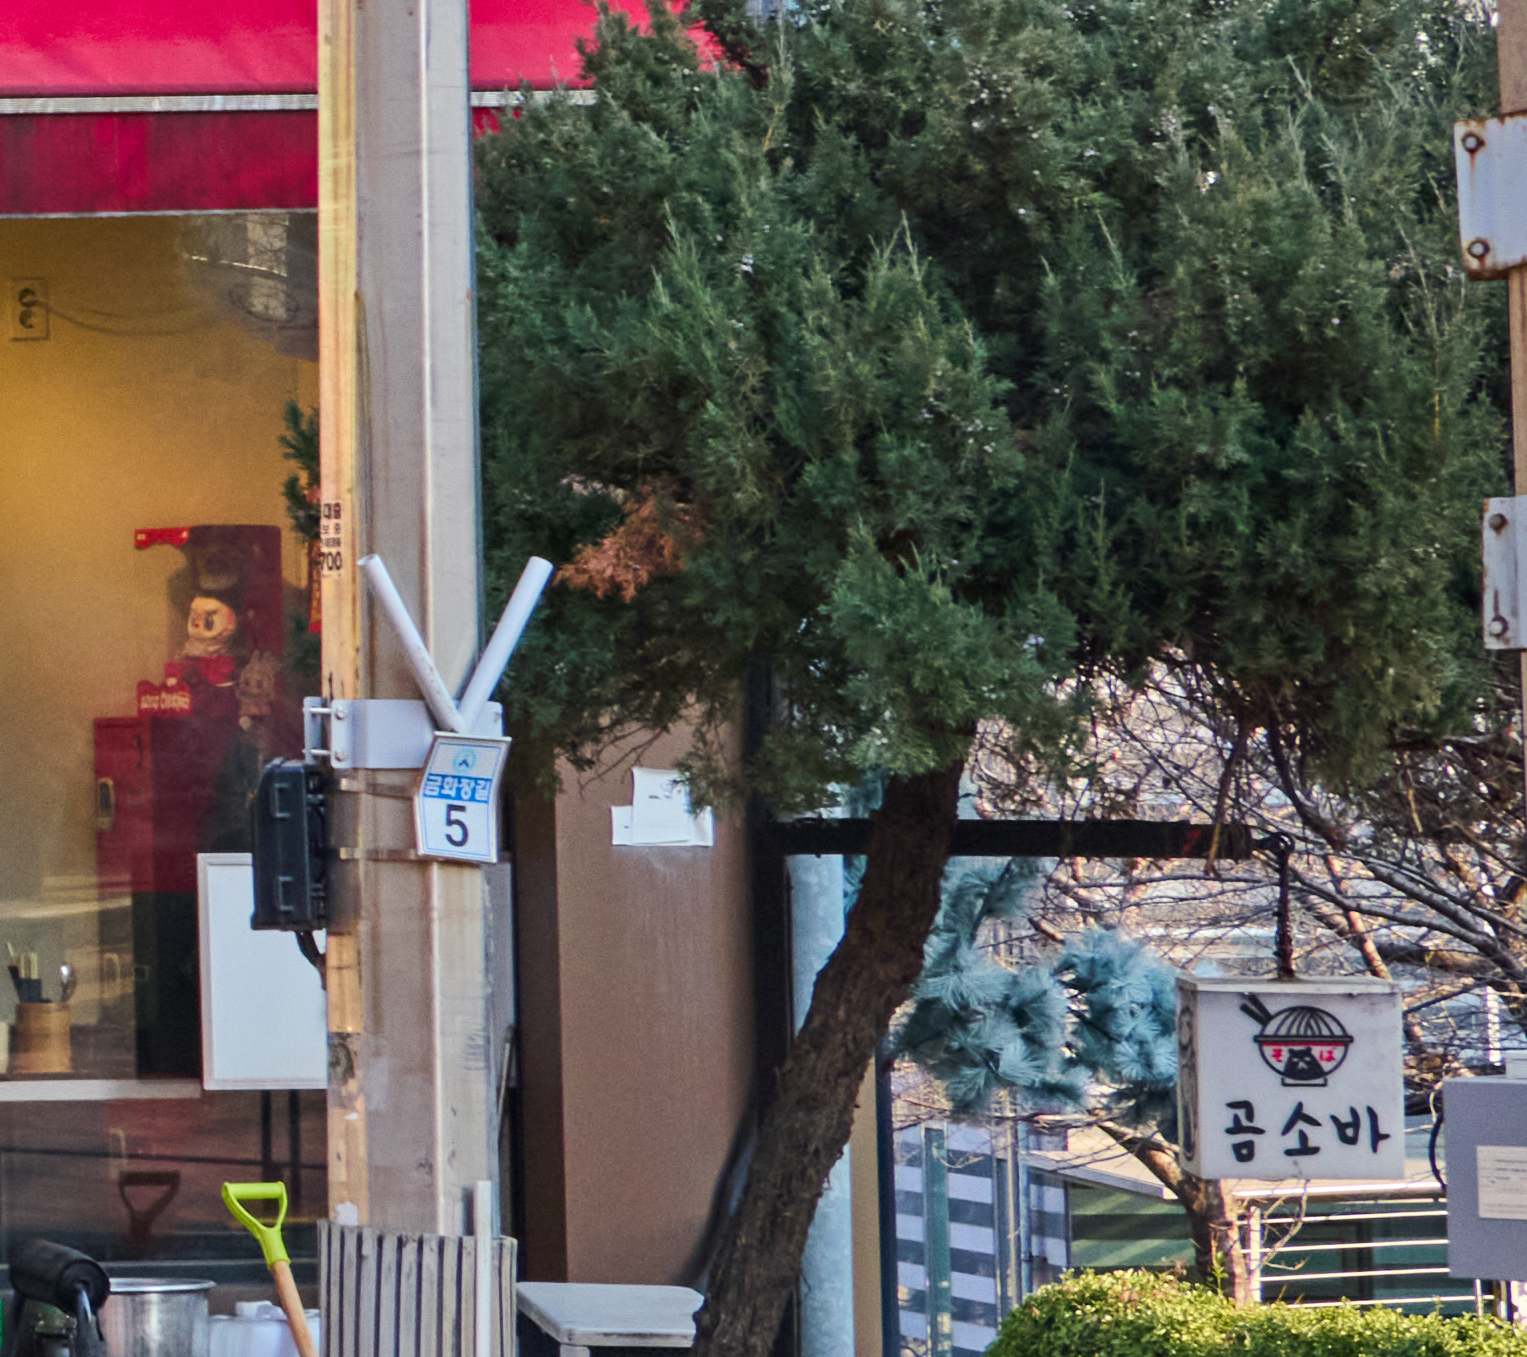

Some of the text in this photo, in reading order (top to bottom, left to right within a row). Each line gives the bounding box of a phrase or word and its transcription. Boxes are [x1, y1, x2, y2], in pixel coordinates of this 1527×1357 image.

[422, 775, 490, 801] 금화장길
[445, 804, 469, 848] 5
[1224, 1100, 1391, 1163] 곰소바
